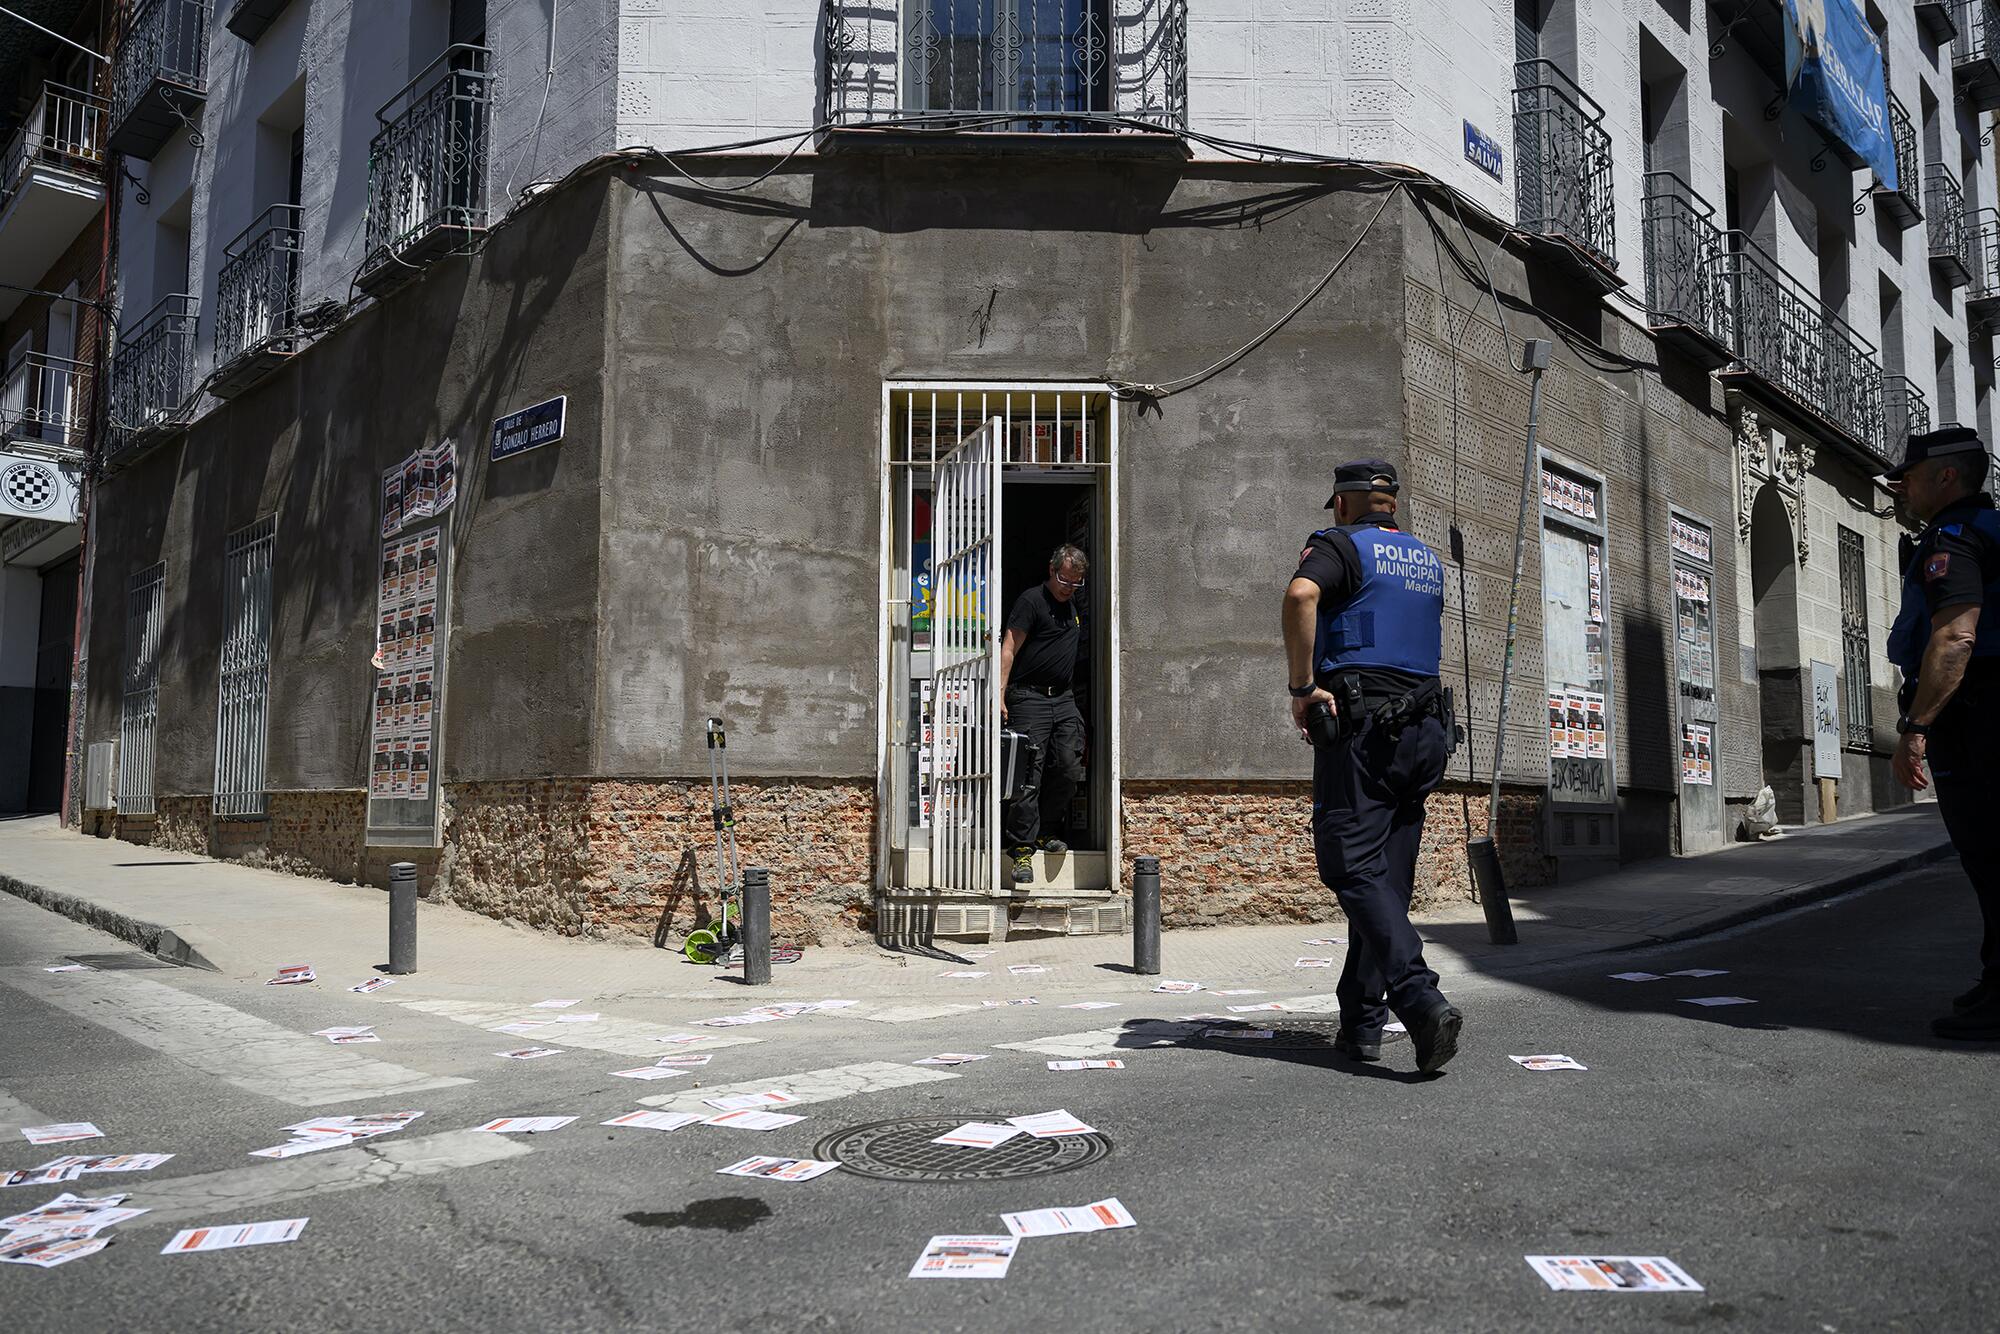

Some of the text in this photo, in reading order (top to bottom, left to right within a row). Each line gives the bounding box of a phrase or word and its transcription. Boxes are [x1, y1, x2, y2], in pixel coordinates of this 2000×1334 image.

[1468, 141, 1502, 176] SALVIA
[502, 418, 558, 451] GONZALO HERRERO
[33, 465, 52, 480] GLASS
[1376, 560, 1441, 584] MUNICIPAL
[1405, 579, 1441, 597] Madrid
[849, 1154, 981, 1180] REGISTRO
